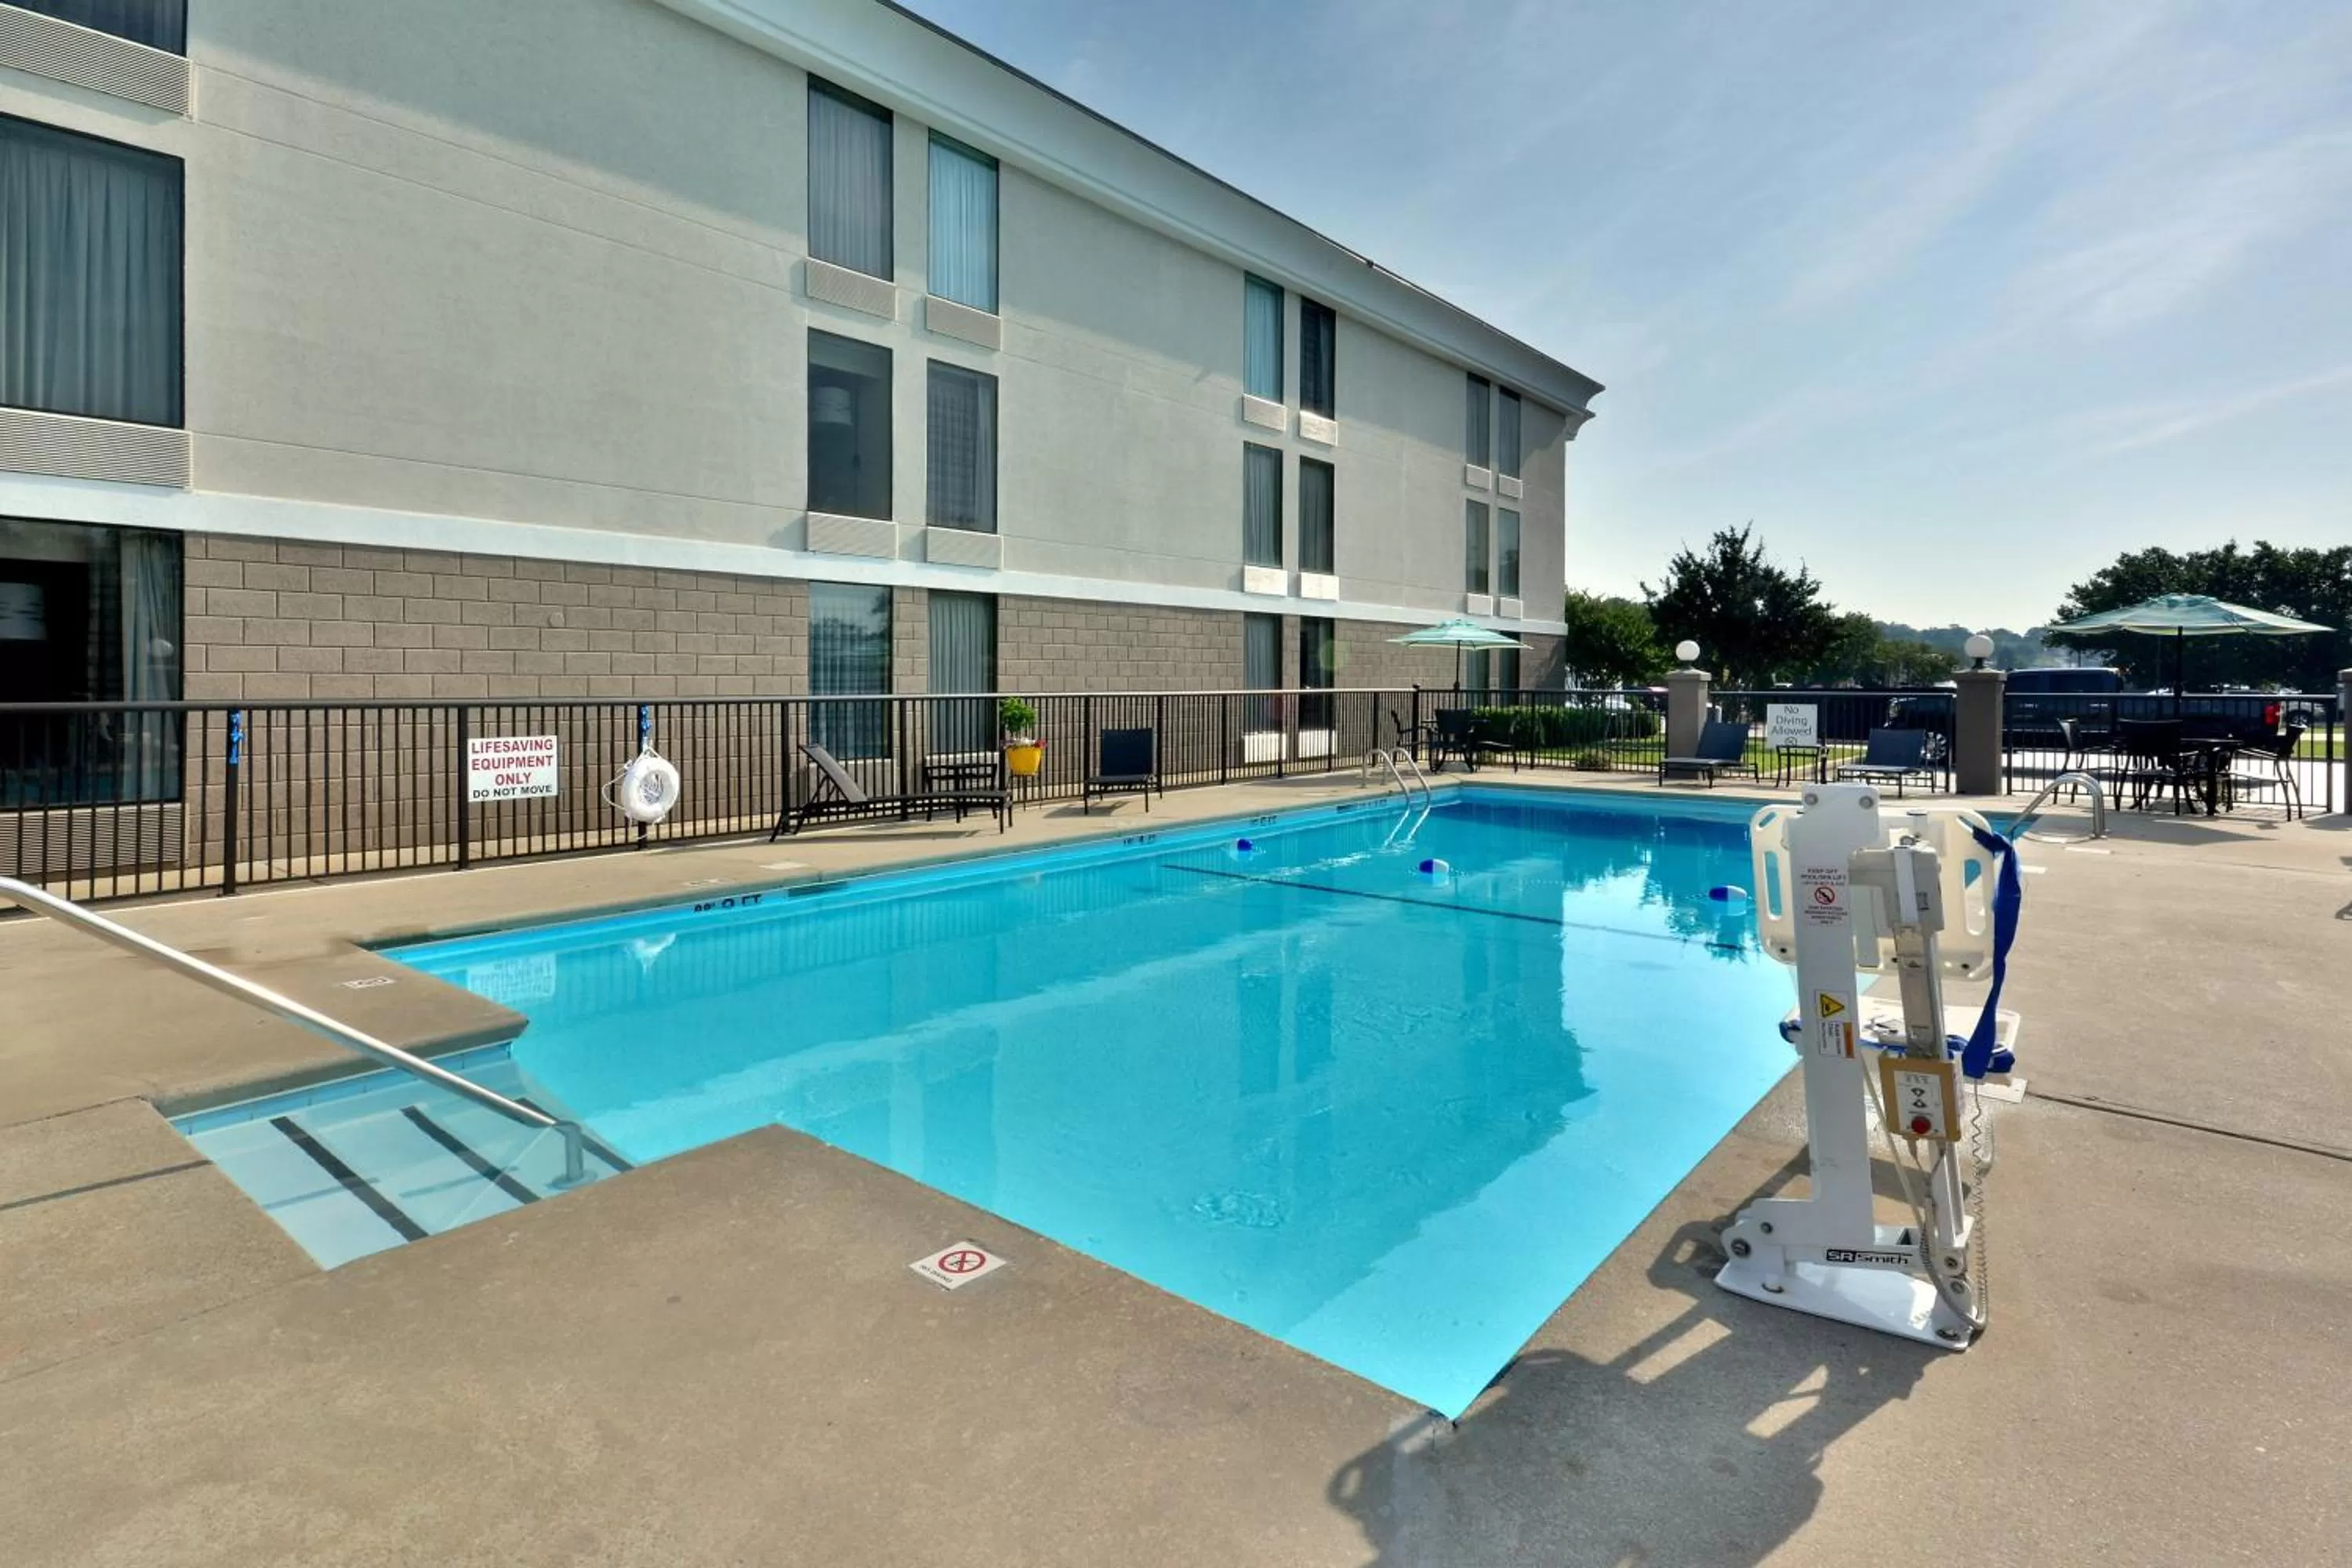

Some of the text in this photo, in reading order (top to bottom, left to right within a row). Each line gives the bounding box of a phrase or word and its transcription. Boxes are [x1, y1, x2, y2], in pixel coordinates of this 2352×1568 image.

[1776, 715, 1807, 726] Diving
[1772, 725, 1812, 735] Allowed
[472, 739, 553, 753] LIFESAVING
[472, 755, 554, 770] EQUIPMENT
[495, 772, 532, 786] ONLY
[473, 784, 552, 798] DO NOT MOVE
